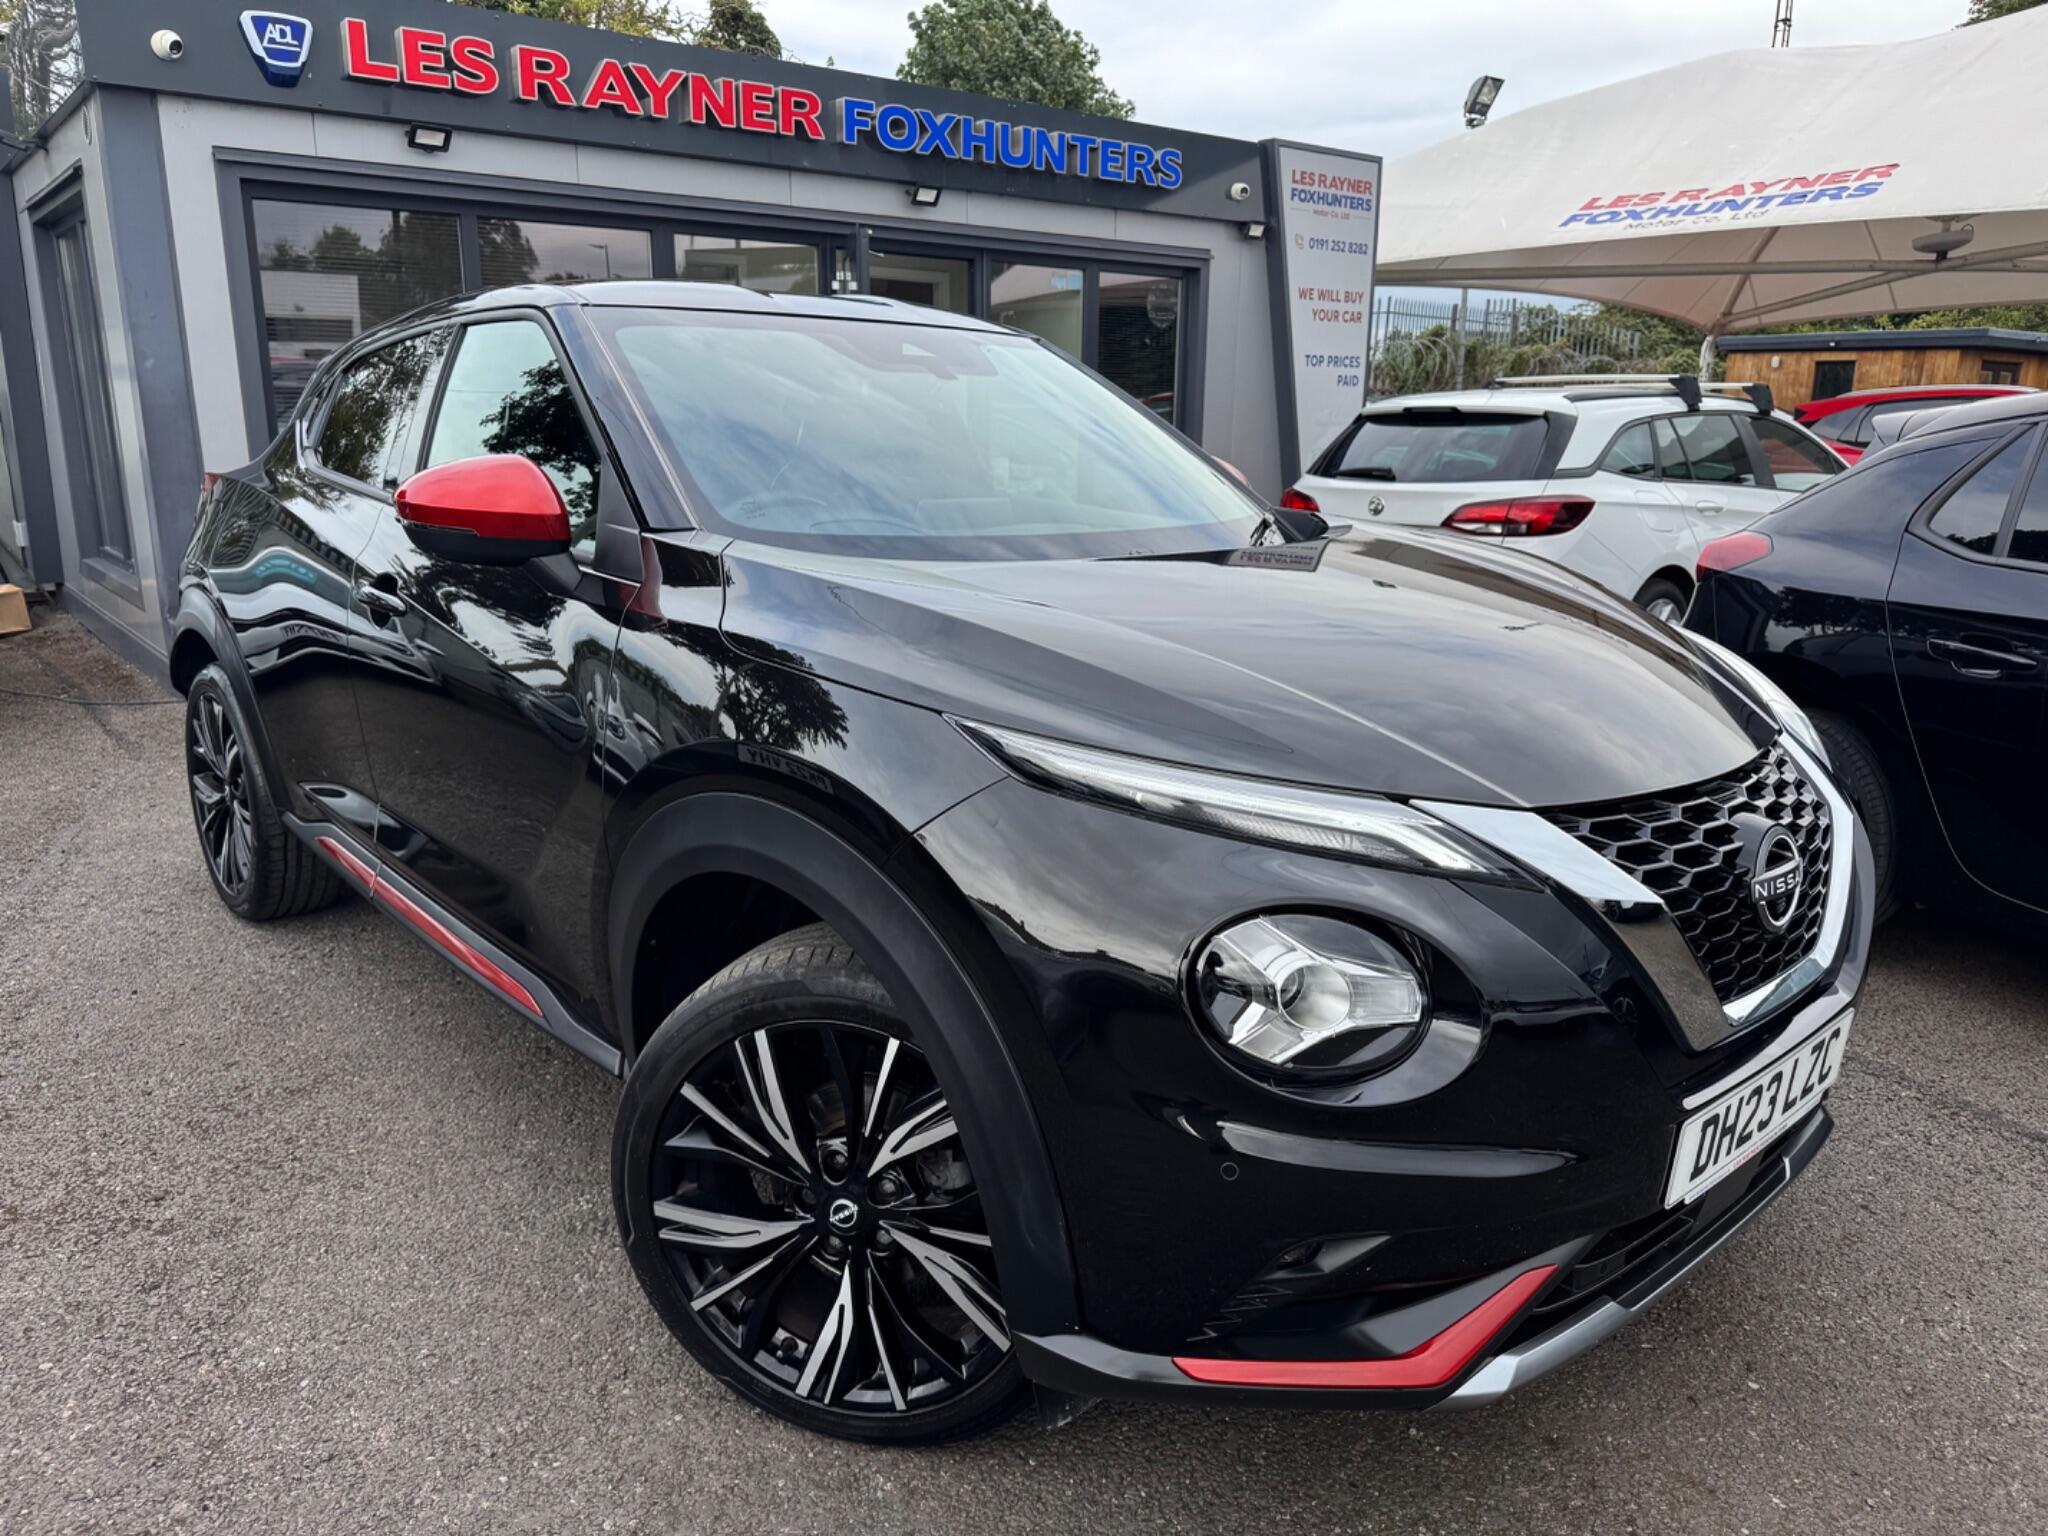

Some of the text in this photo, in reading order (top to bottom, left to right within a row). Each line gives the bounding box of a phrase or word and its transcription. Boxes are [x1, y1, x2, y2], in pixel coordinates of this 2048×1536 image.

[262, 22, 300, 48] ADL
[340, 16, 1183, 190] LES RAYNER FOXHUNTERS
[1292, 168, 1373, 196] LES RAYNER
[1578, 163, 1901, 212] LES RAYNER
[1290, 187, 1373, 212] FOXHUNTERS
[1558, 181, 1885, 229] FOXHUNTERS
[1308, 236, 1369, 256] 0191 252 8282
[1298, 287, 1365, 304] WE WILL BUY
[1312, 308, 1362, 324] YOUR CAR
[1304, 354, 1361, 370] TOP PRICES
[1336, 374, 1360, 388] PAID
[1688, 1069, 1784, 1183] DH23
[1780, 1026, 1841, 1116] LZC
